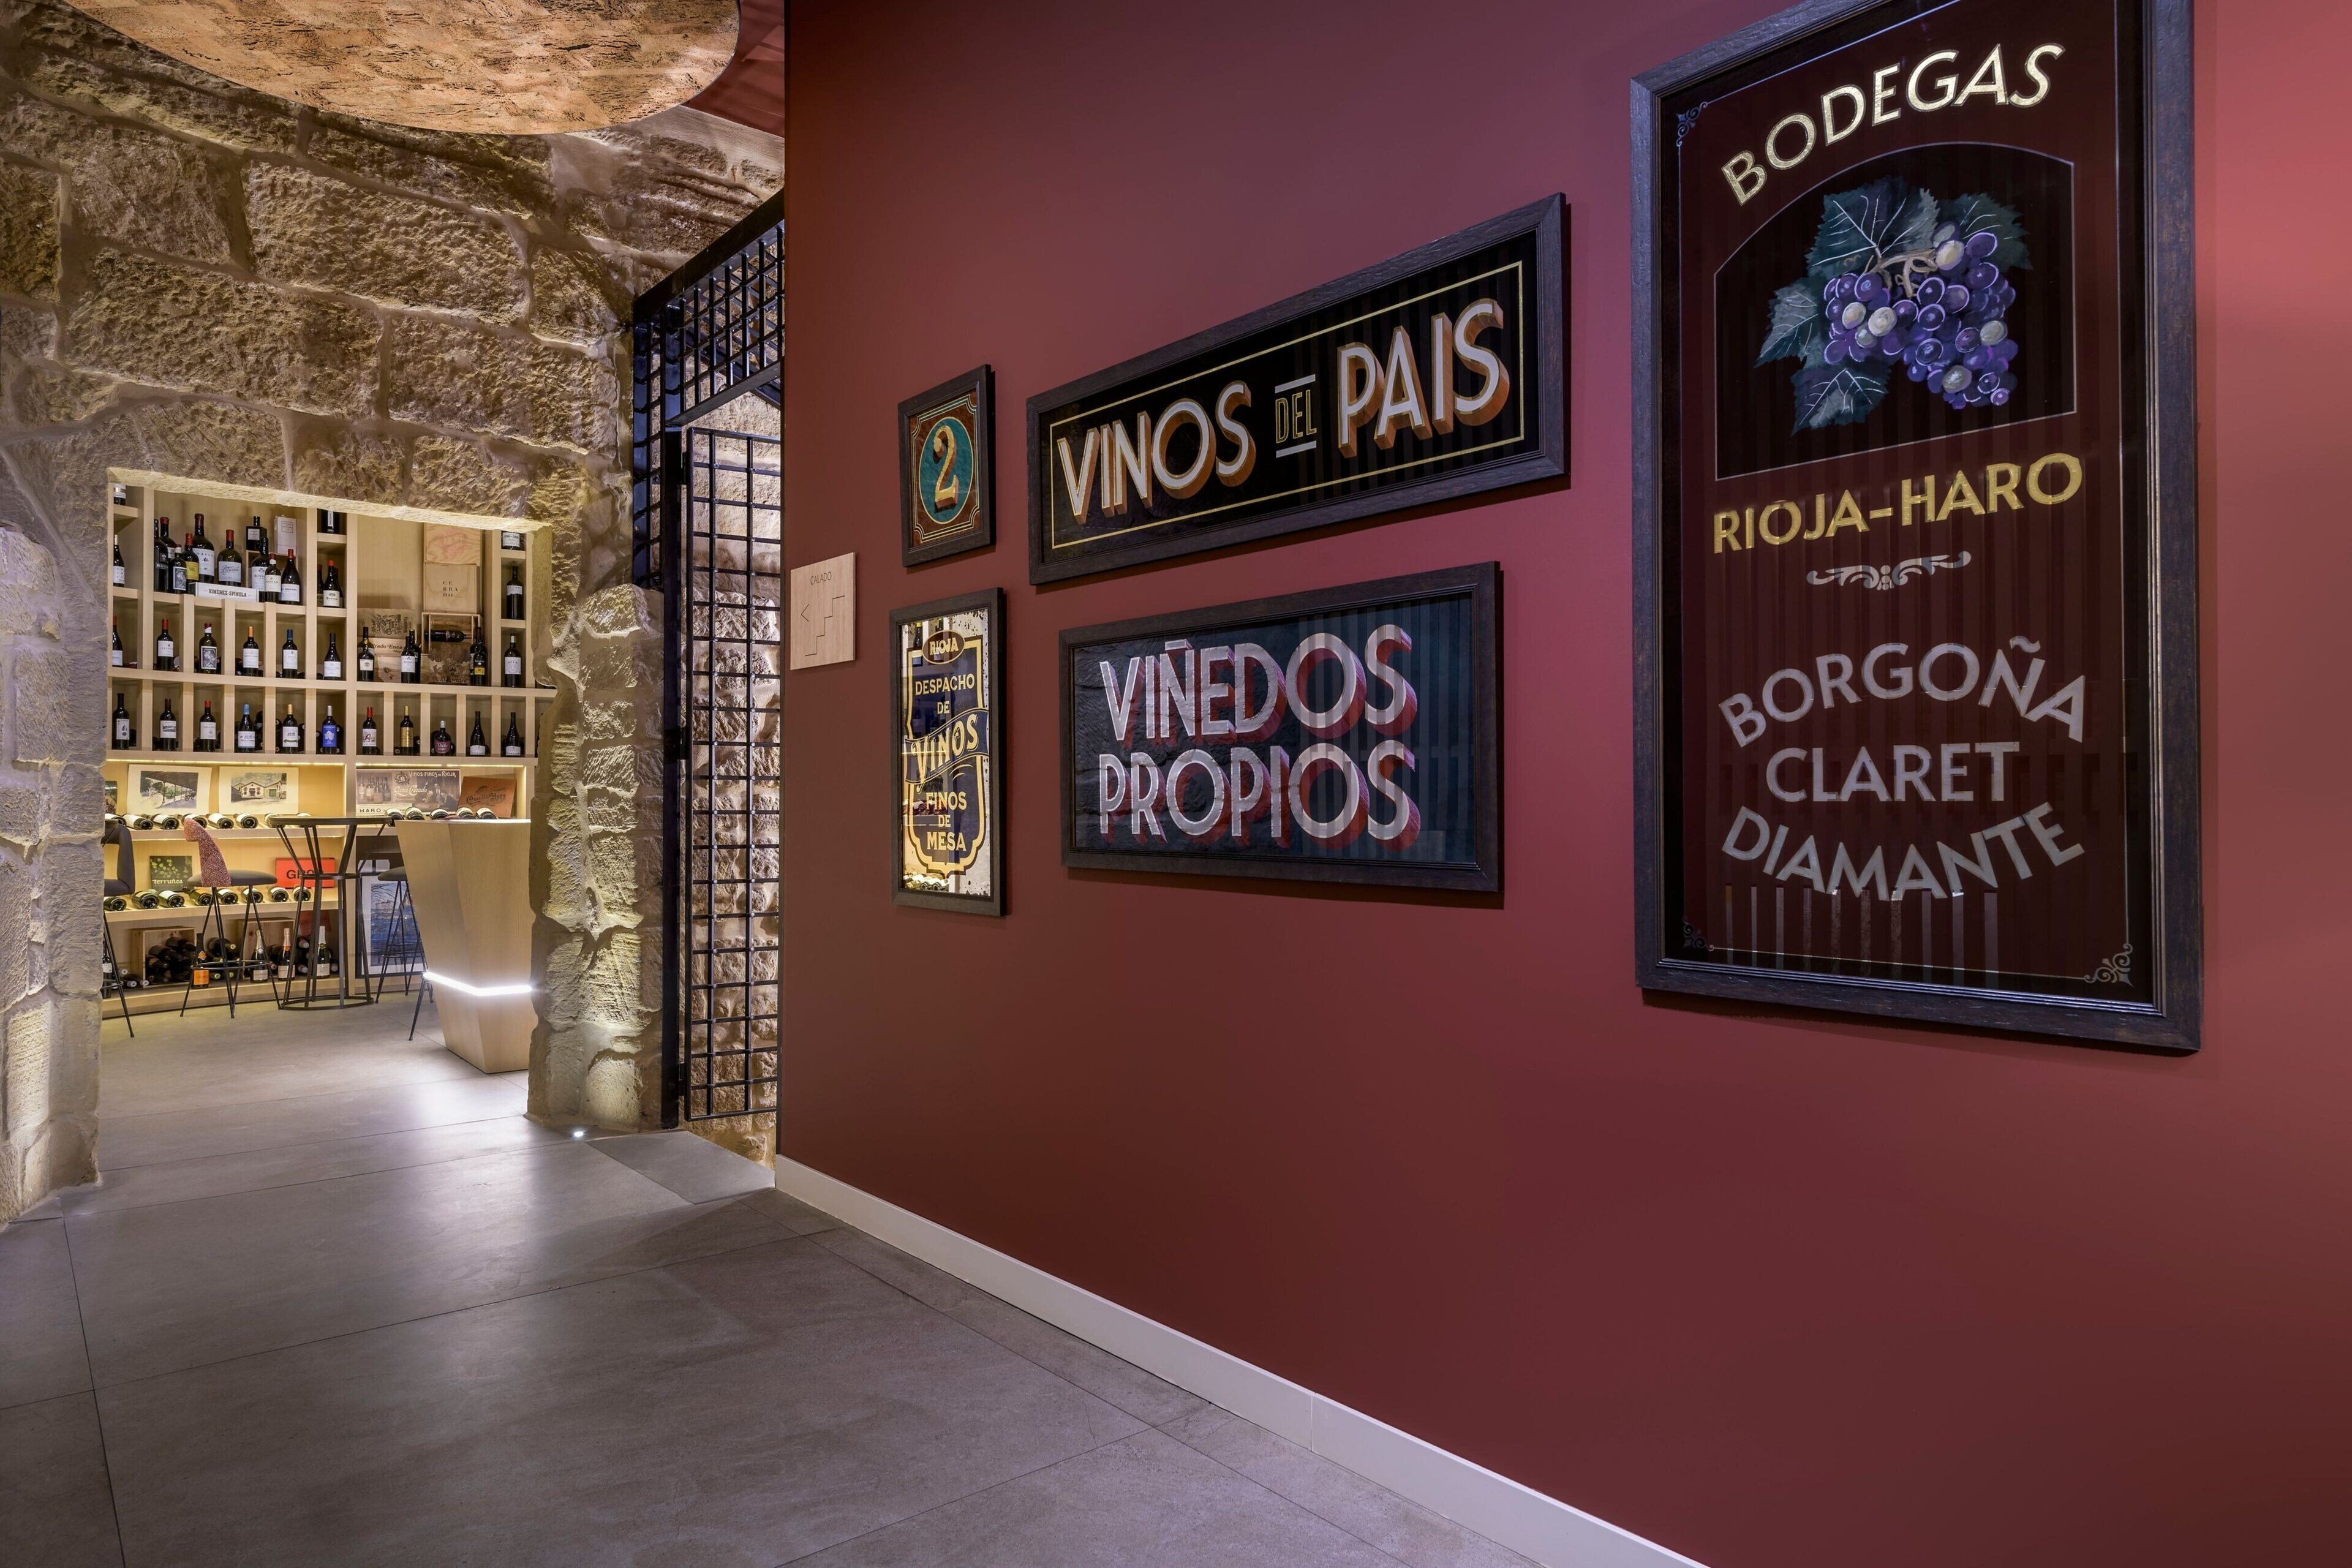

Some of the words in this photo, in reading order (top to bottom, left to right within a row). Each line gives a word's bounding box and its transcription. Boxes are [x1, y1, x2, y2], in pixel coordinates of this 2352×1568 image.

[1721, 43, 2065, 206] BODEGAS
[1057, 380, 1256, 524] VINOS
[1275, 389, 1317, 443] DEL
[1338, 298, 1509, 458] PAIS
[932, 424, 959, 513] 2
[1714, 453, 2082, 553] RIOJA-HARO
[810, 571, 832, 585] CALADO
[915, 674, 975, 696] DESPACHO
[929, 638, 959, 655] RIOJA
[937, 700, 950, 715] DE
[1099, 624, 1417, 750] VIÑEDOS
[1718, 636, 2086, 748] BORGOÑA
[911, 714, 979, 794] VINOS
[1766, 741, 2020, 803] CLARET
[926, 791, 967, 810] FINOS
[938, 815, 951, 827] DE
[1099, 740, 1420, 851] PROPIOS
[927, 831, 967, 851] MESA
[1721, 801, 2084, 901] DIAMANTE
